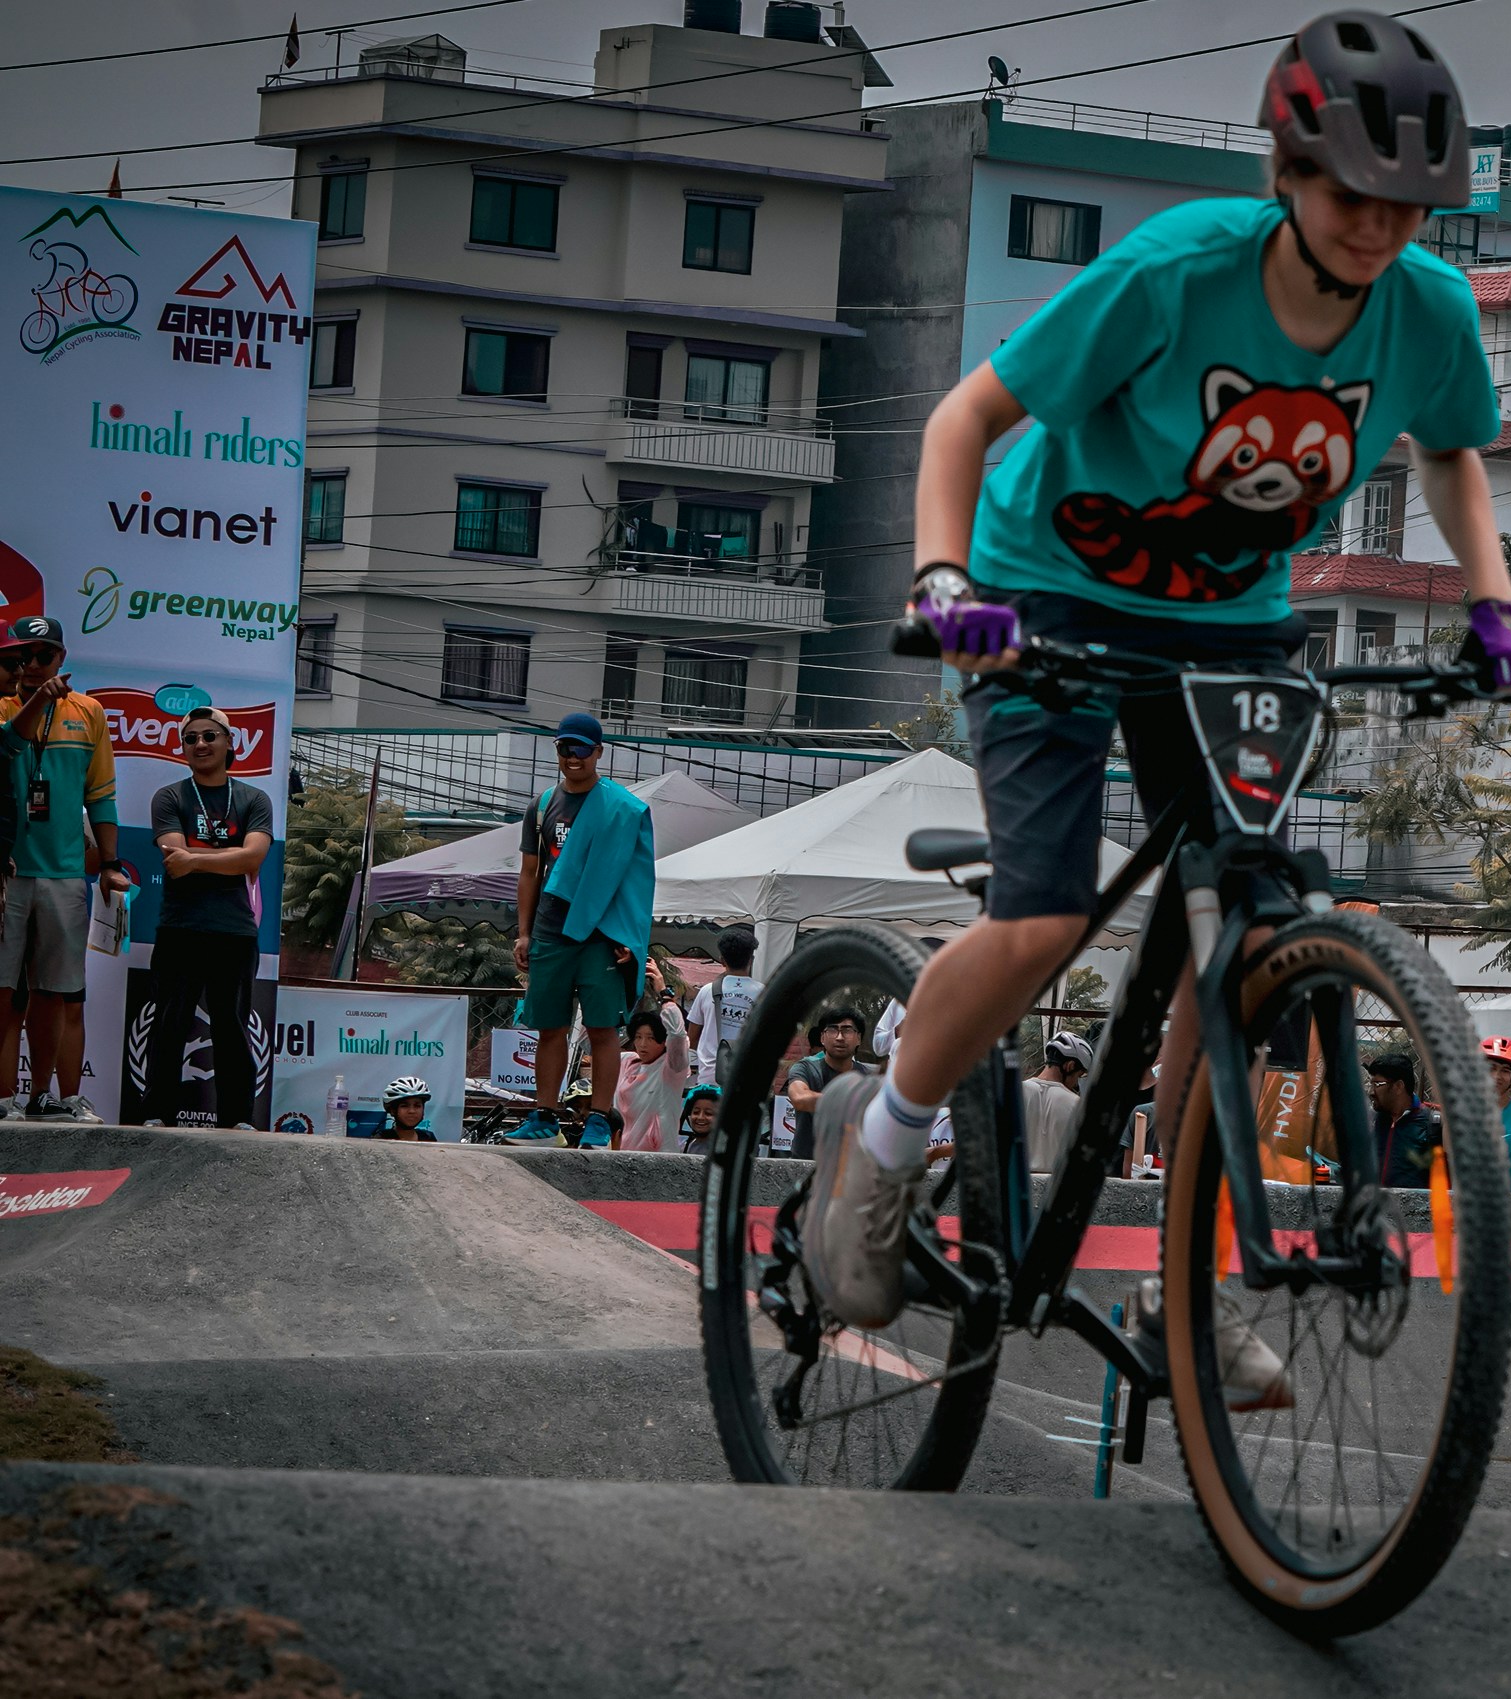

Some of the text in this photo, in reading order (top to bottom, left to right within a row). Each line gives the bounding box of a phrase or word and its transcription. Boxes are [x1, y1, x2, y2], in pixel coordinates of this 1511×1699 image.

[157, 303, 312, 346] GRAVITY
[44, 330, 141, 367] Nepal Cycling Association
[172, 335, 272, 370] NEPAL
[91, 402, 302, 468] himali riders
[108, 491, 278, 546] vianet
[128, 588, 299, 632] greenway
[221, 622, 276, 643] Nepal
[1231, 690, 1281, 733] 18
[105, 708, 264, 762] Everyay
[197, 826, 228, 836] TRCK
[339, 1027, 444, 1057] himali riders
[497, 1075, 513, 1083] NO
[176, 1110, 218, 1122] OUNTAI
